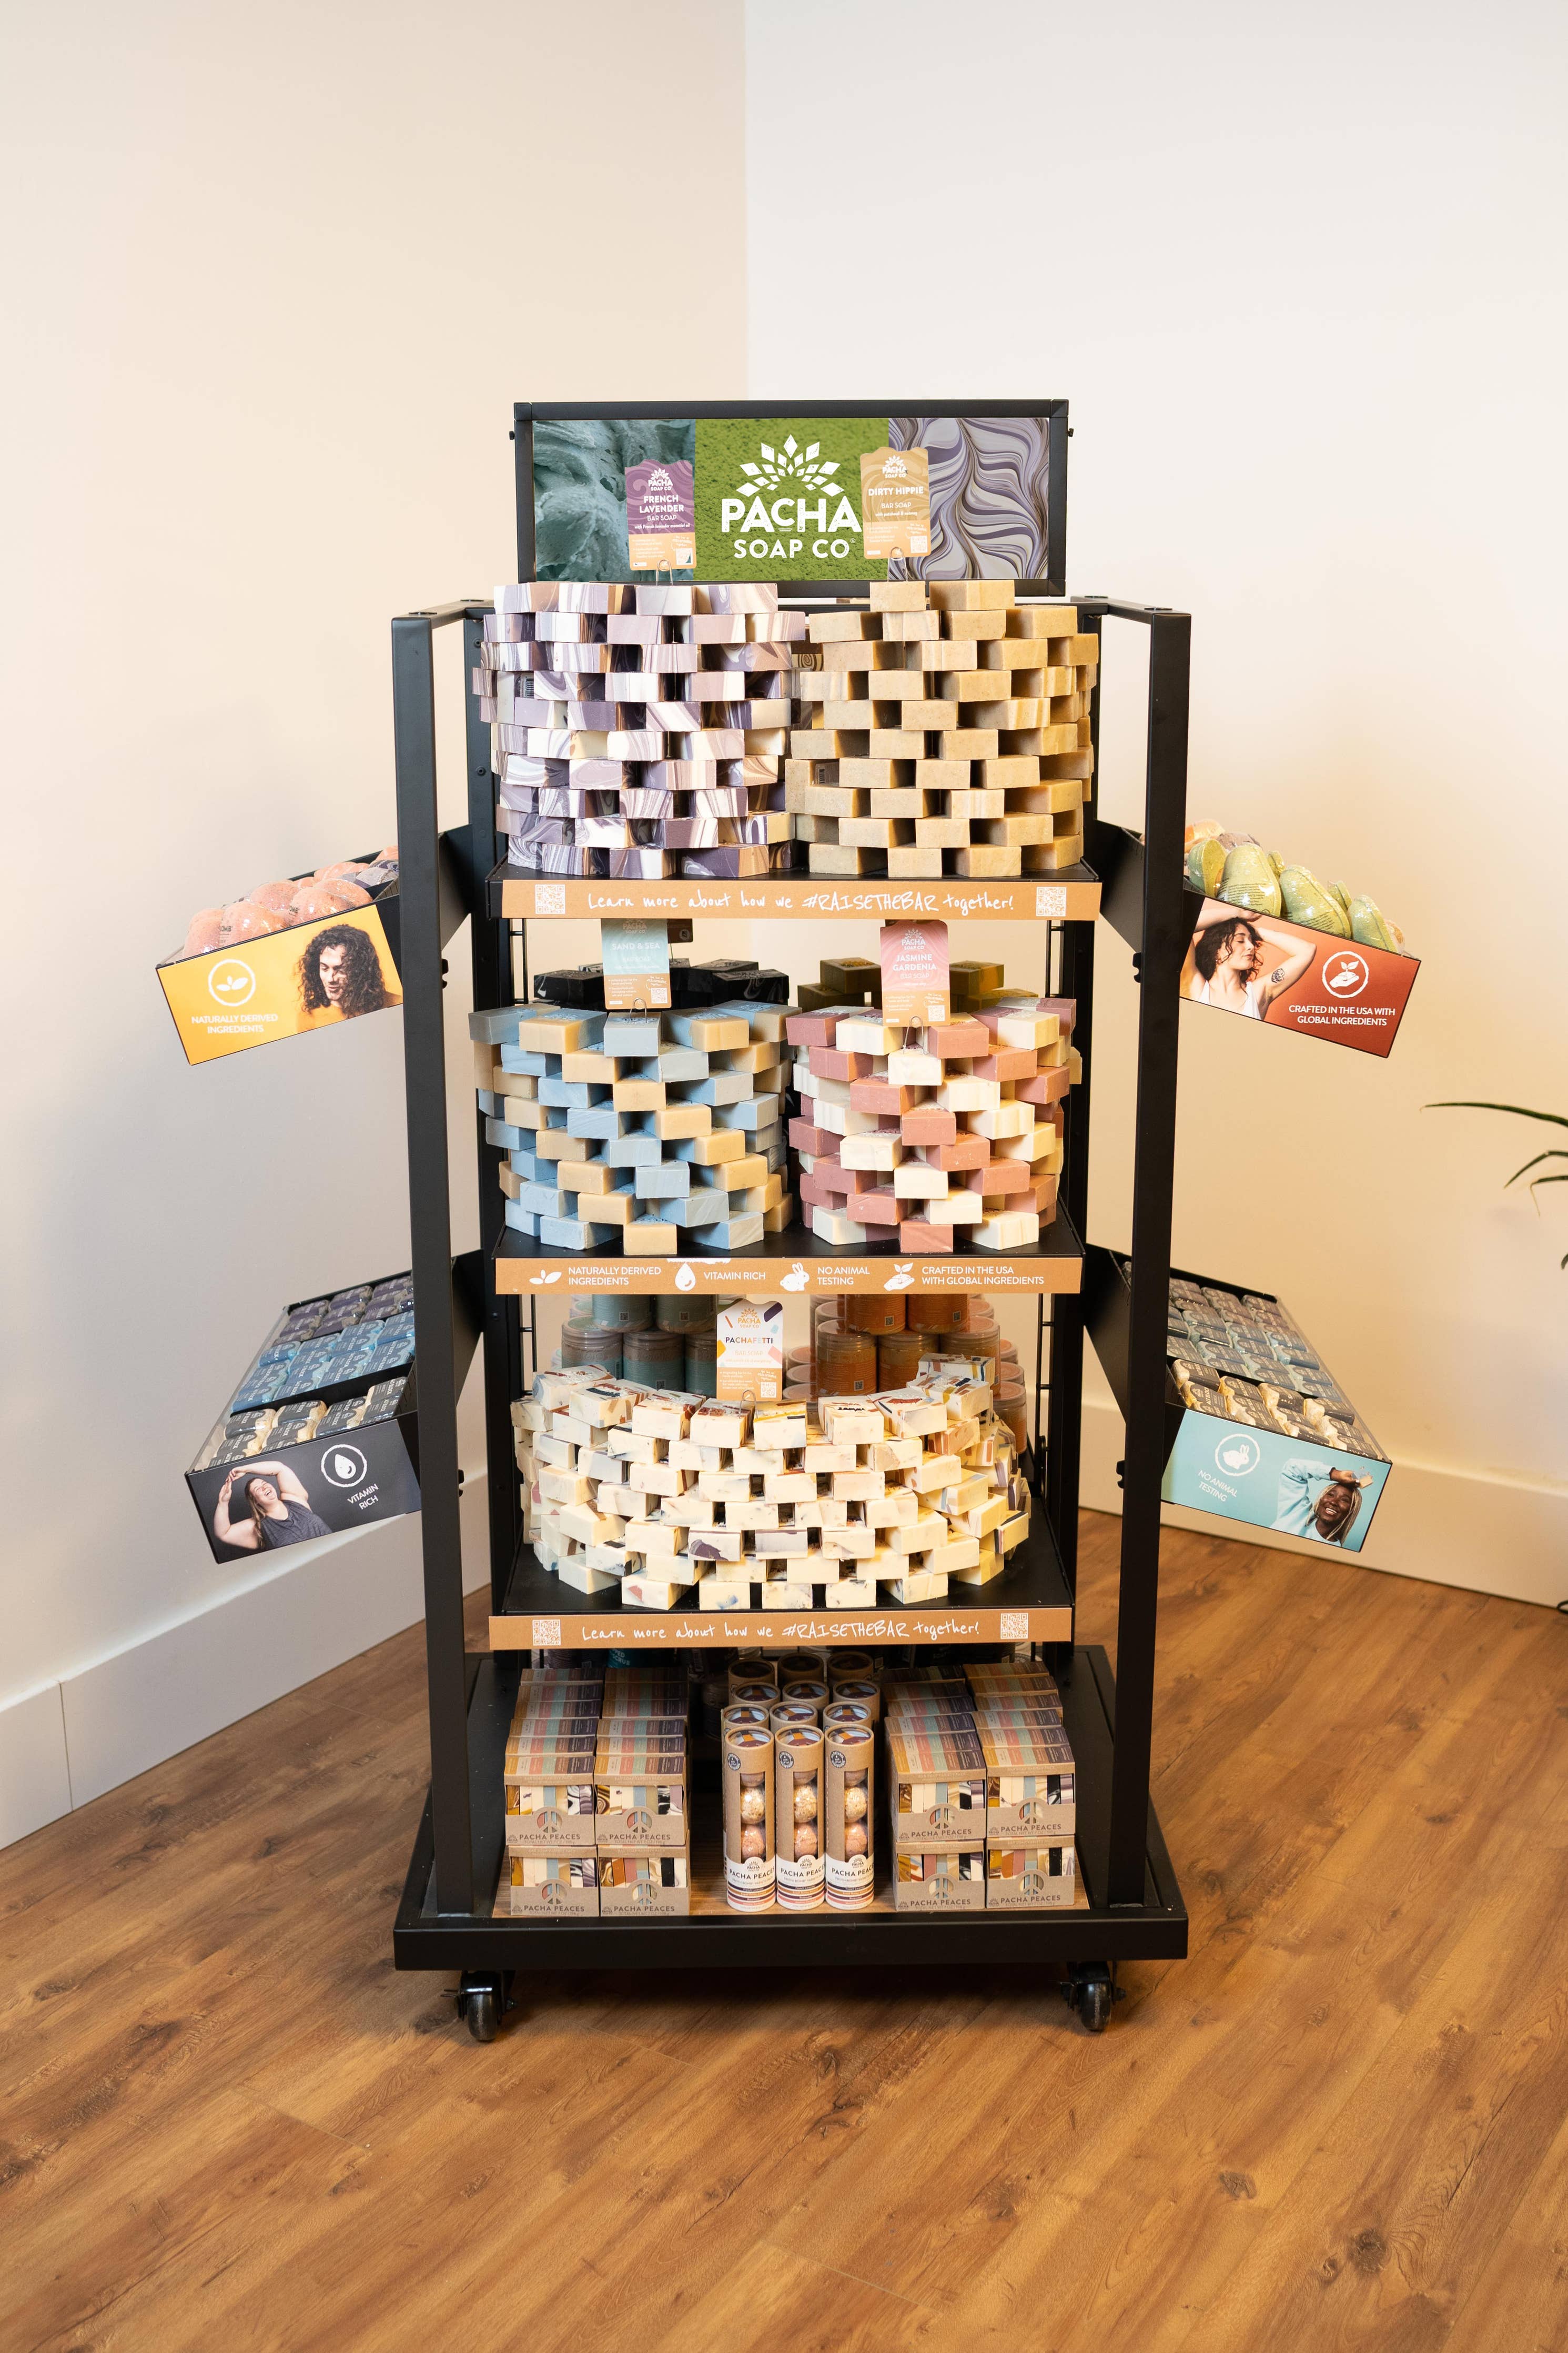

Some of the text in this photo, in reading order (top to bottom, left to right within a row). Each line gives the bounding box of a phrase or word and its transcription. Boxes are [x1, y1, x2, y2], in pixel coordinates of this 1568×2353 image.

[868, 486, 924, 496] DIRTY HIPPIE
[643, 495, 679, 504] FRENCH
[639, 504, 684, 514] LAVENDER
[722, 496, 862, 532] PACHA
[734, 539, 803, 558] SOAP
[589, 889, 1014, 916] Learn more about how we #RAISETHEBAR together!
[191, 1013, 278, 1024] NATURALLY DERIVED
[1332, 1017, 1387, 1025] INGREDIENTS
[207, 1025, 264, 1034] INGREDIENTS
[568, 1266, 661, 1275] NATURALLY DERIVED
[704, 1271, 766, 1280] VITAMIN RICH
[817, 1266, 870, 1275] NO ANIMAL
[922, 1266, 1014, 1275] CRAFTED IN THE USA
[568, 1276, 629, 1285] INGREDIENTS
[817, 1276, 854, 1285] TESTING
[922, 1276, 1044, 1285] WITH GLOBAL INGREDIENTS
[1198, 1470, 1237, 1497] NO ANIMAL
[347, 1483, 379, 1504] VITAMIN
[1199, 1481, 1228, 1502] TESTING
[359, 1495, 379, 1510] RICH
[582, 1621, 979, 1641] Learn more about how we #RAISETHEBAR together!
[730, 1866, 775, 1879] PACHA PEACES
[781, 1864, 825, 1877] PACHA PEACE
[832, 1868, 855, 1876] PACHA
